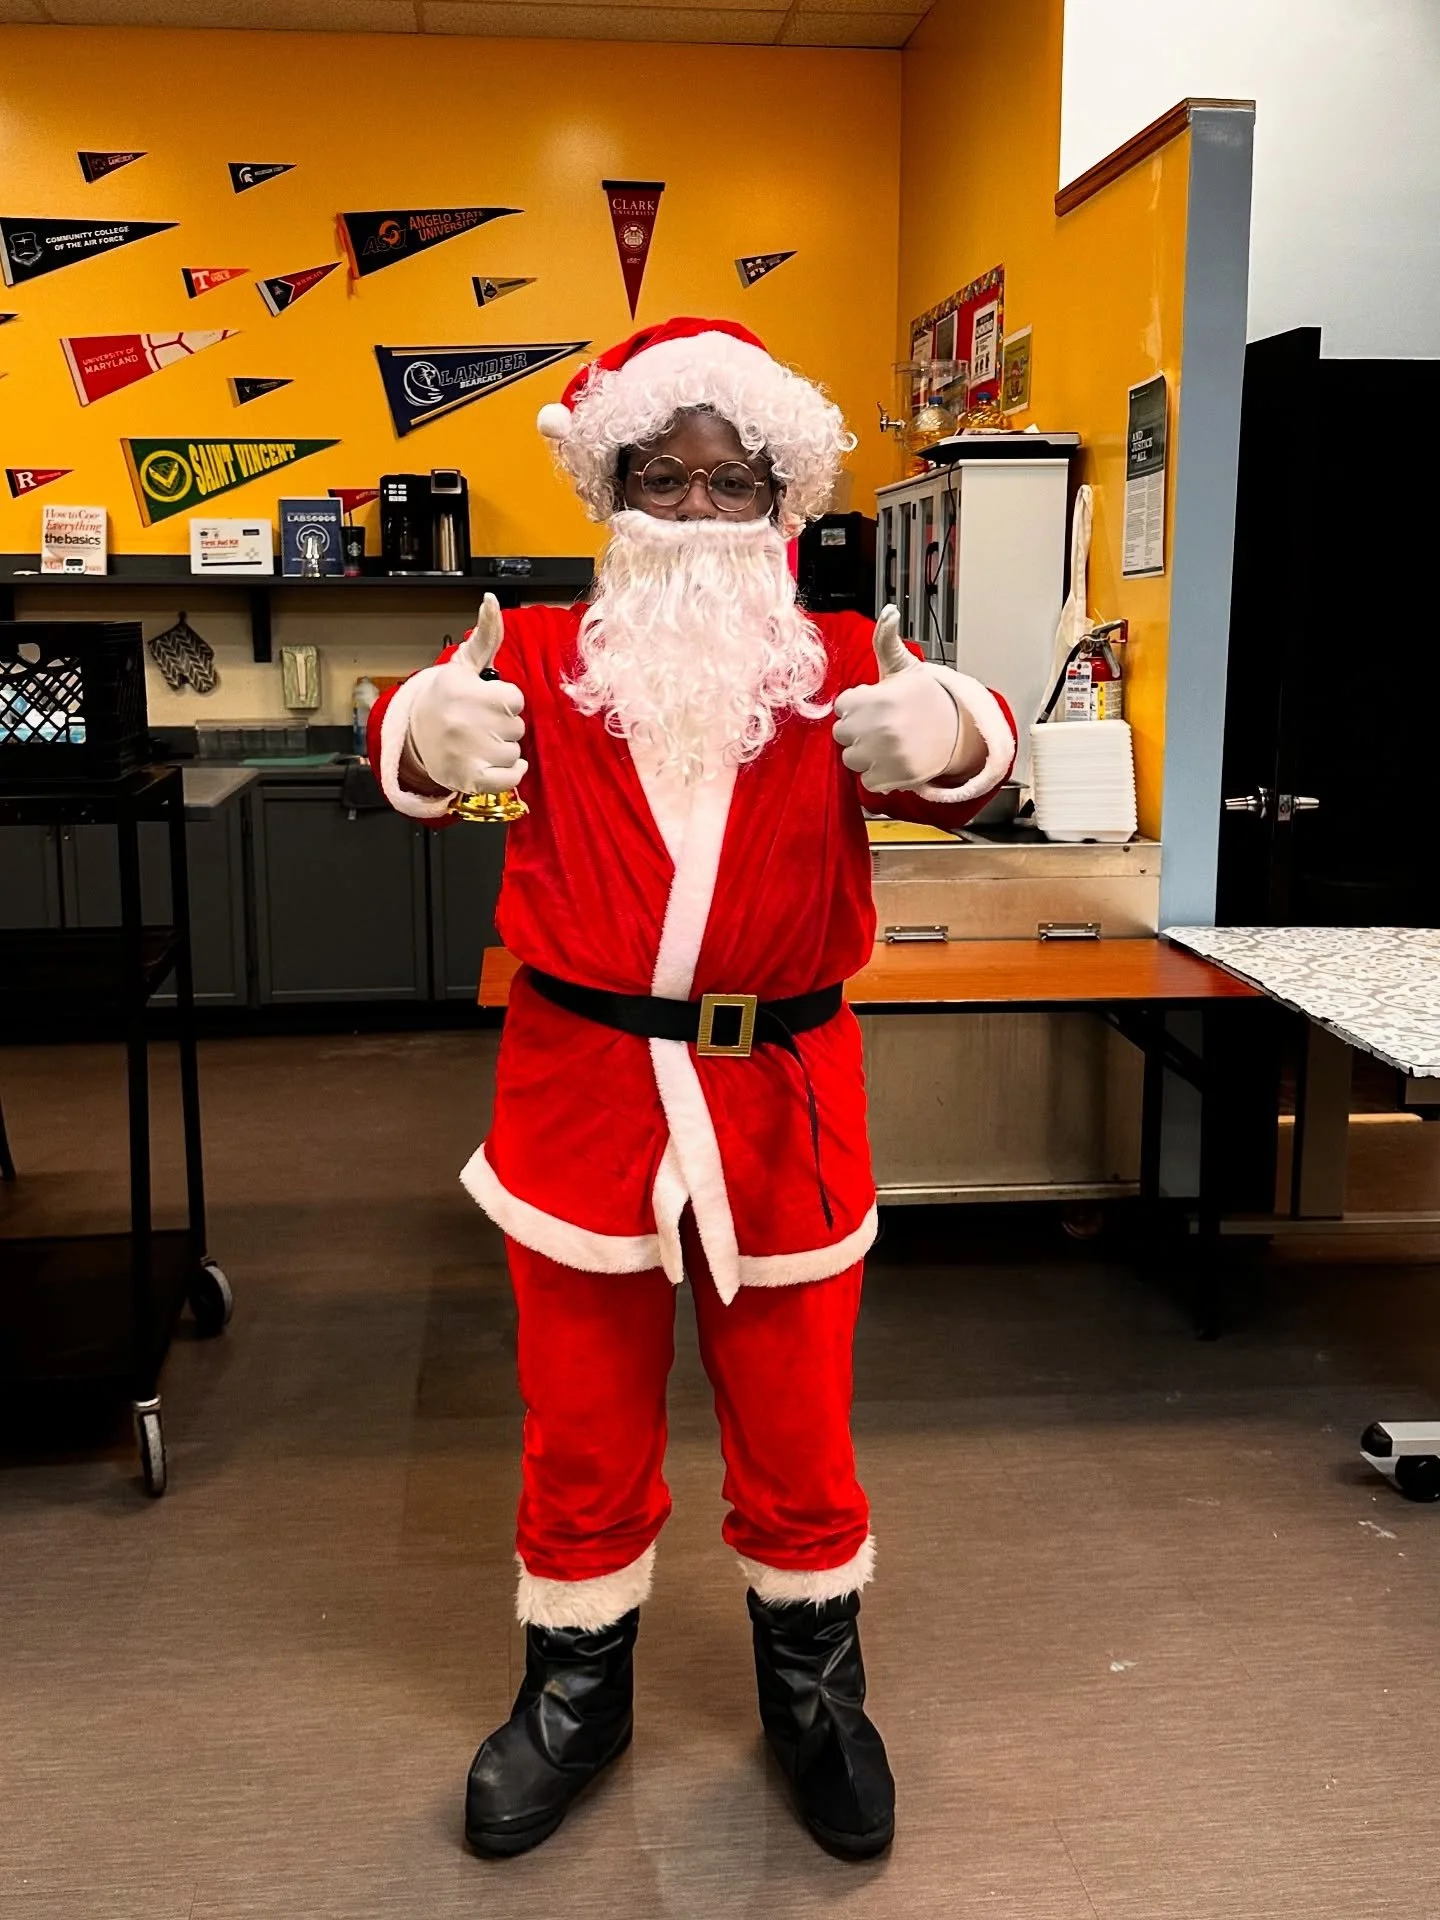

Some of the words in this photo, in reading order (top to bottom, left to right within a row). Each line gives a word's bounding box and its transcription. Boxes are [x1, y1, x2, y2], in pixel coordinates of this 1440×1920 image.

[409, 213, 450, 231] ANGELO
[454, 210, 484, 222] STATE
[45, 231, 93, 244] COMMUNITY
[94, 225, 130, 237] COLLEGE
[98, 234, 125, 244] FORCE
[418, 218, 479, 242] UNIVERSITY
[191, 270, 210, 290] T
[82, 350, 125, 366] UNIVERSITY
[84, 354, 139, 374] MARYLAND
[440, 352, 528, 386] LANDER
[460, 372, 504, 389] BEARCATS
[188, 444, 237, 496] SAINT
[234, 444, 296, 478] VINCENT
[16, 472, 38, 488] R
[46, 509, 66, 518] How
[47, 520, 102, 535] Everything
[45, 533, 64, 544] the
[64, 534, 102, 546] basics
